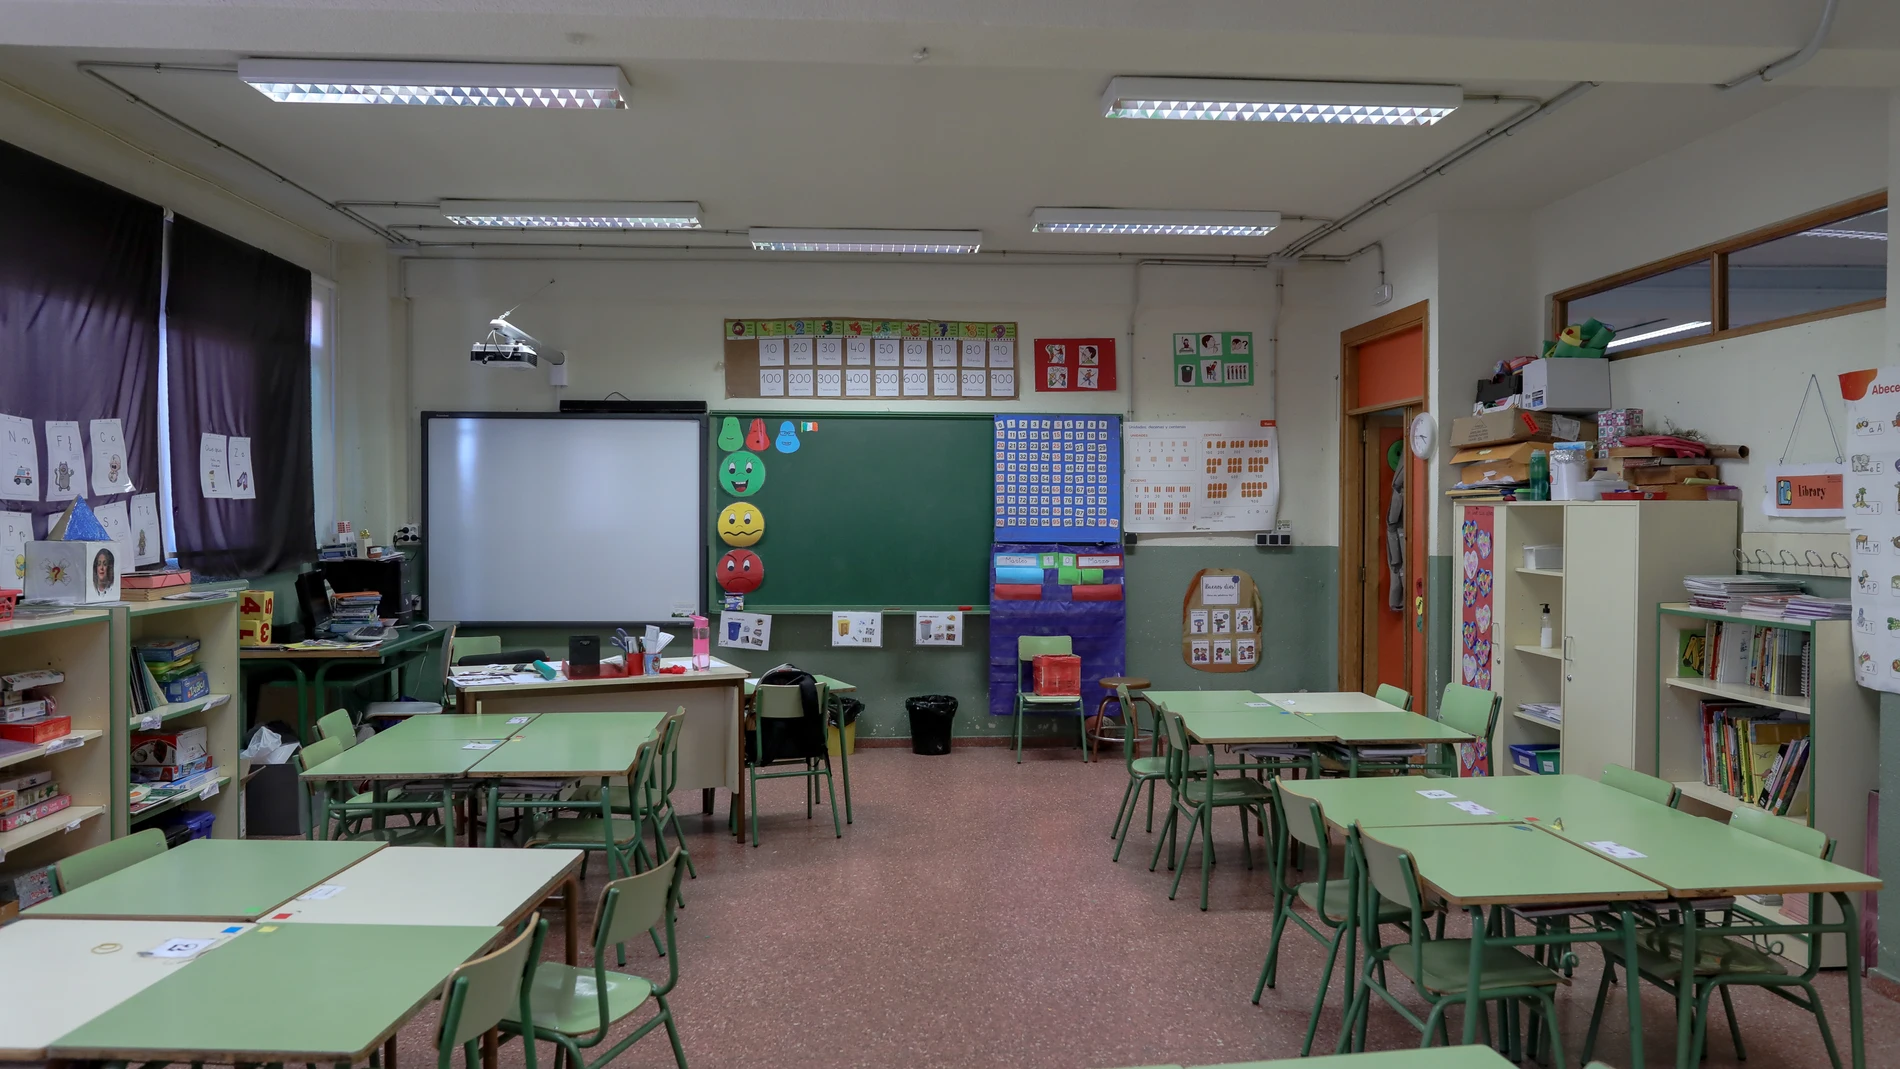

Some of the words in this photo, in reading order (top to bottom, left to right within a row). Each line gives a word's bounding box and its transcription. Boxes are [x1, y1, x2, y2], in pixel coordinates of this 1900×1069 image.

[795, 320, 805, 335] 2
[823, 320, 833, 334] 3
[881, 322, 890, 336] 5
[939, 323, 948, 337] 7
[968, 323, 977, 337] 8
[765, 343, 777, 353] 10
[793, 343, 807, 353] 20
[822, 343, 836, 353] 30
[851, 343, 865, 353] 40
[879, 344, 894, 354] 50
[907, 344, 922, 355] 60
[937, 345, 951, 355] 70
[966, 345, 981, 355] 80
[994, 345, 1008, 355] 90
[761, 374, 781, 383] 100
[789, 374, 811, 384] 200
[818, 374, 839, 384] 300
[846, 374, 868, 383] 400
[876, 374, 897, 384] 500
[904, 373, 926, 383] 600
[935, 373, 956, 383] 700
[962, 374, 984, 384] 800
[991, 374, 1013, 384] 900
[1877, 424, 1882, 432] A
[9, 431, 16, 443] N
[57, 435, 62, 447] F
[100, 432, 105, 443] C
[1876, 463, 1881, 472] E
[103, 517, 109, 527] S
[9, 525, 14, 536] P
[1873, 543, 1878, 552] M
[240, 596, 260, 614] 4
